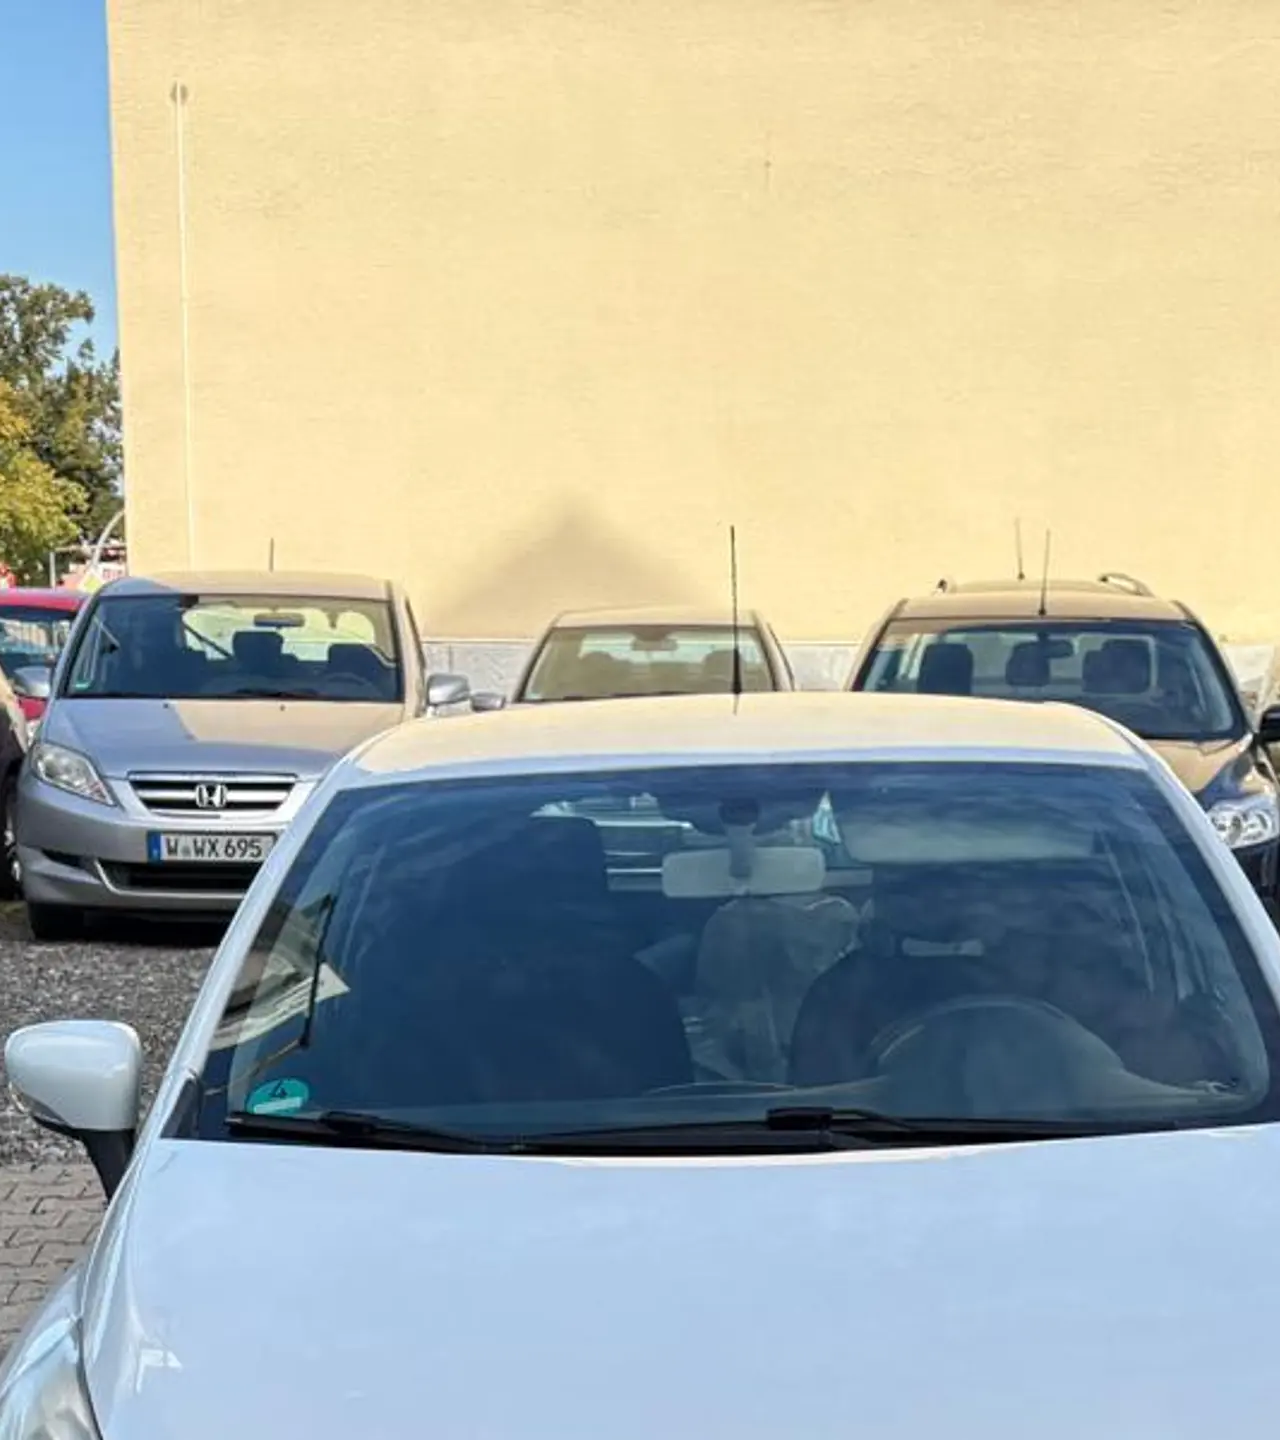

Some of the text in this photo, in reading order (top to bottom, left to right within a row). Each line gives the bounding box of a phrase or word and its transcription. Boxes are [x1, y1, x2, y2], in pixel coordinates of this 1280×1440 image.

[165, 837, 263, 859] W WX 695
